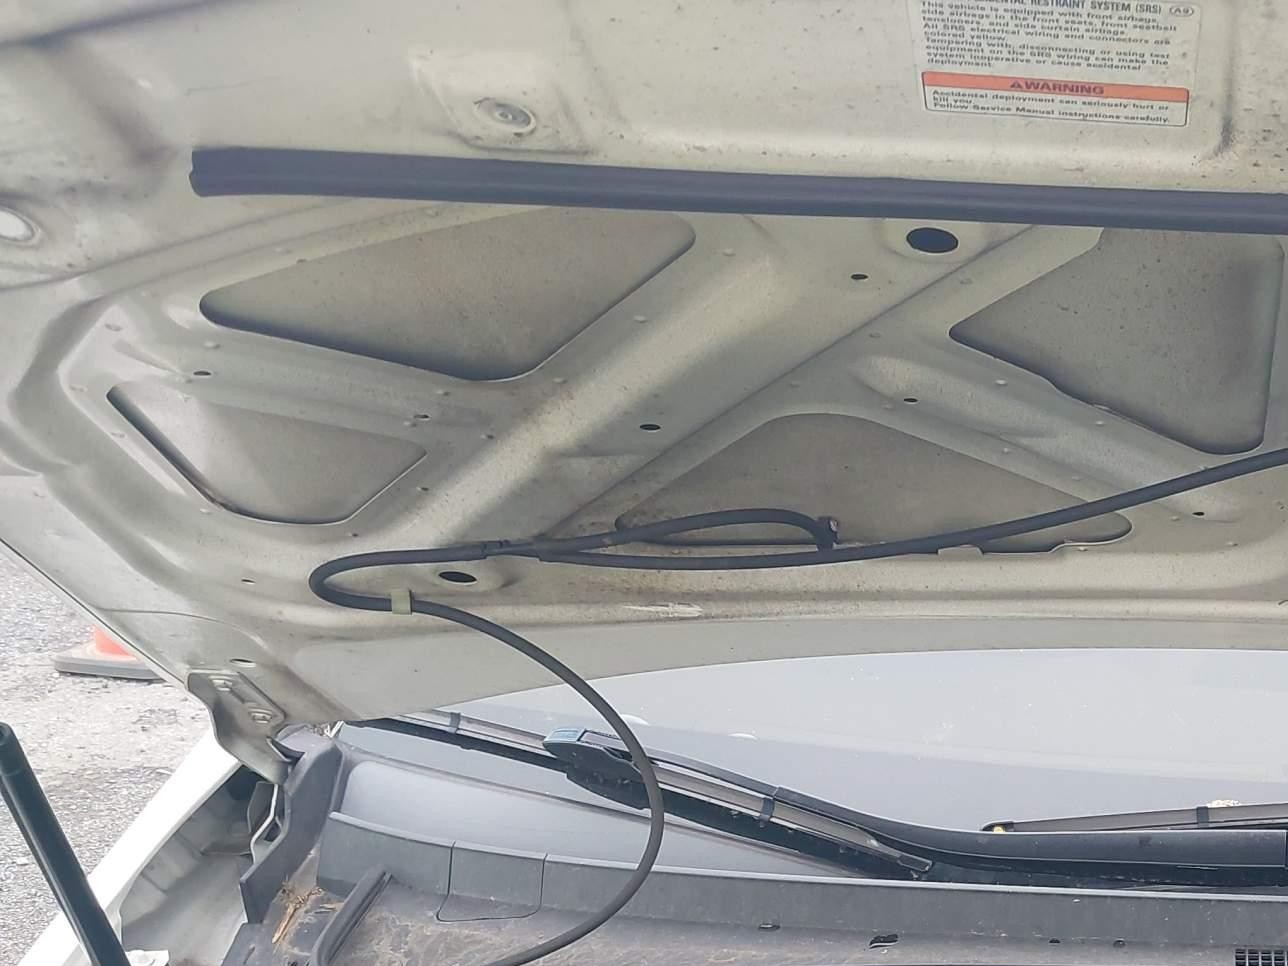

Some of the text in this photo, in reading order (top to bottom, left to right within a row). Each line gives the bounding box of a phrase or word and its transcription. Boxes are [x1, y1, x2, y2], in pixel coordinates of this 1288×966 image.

[1090, 0, 1131, 12] SYSTEM
[1135, 4, 1161, 14] (SRS)
[1024, 81, 1104, 95] WARNING
